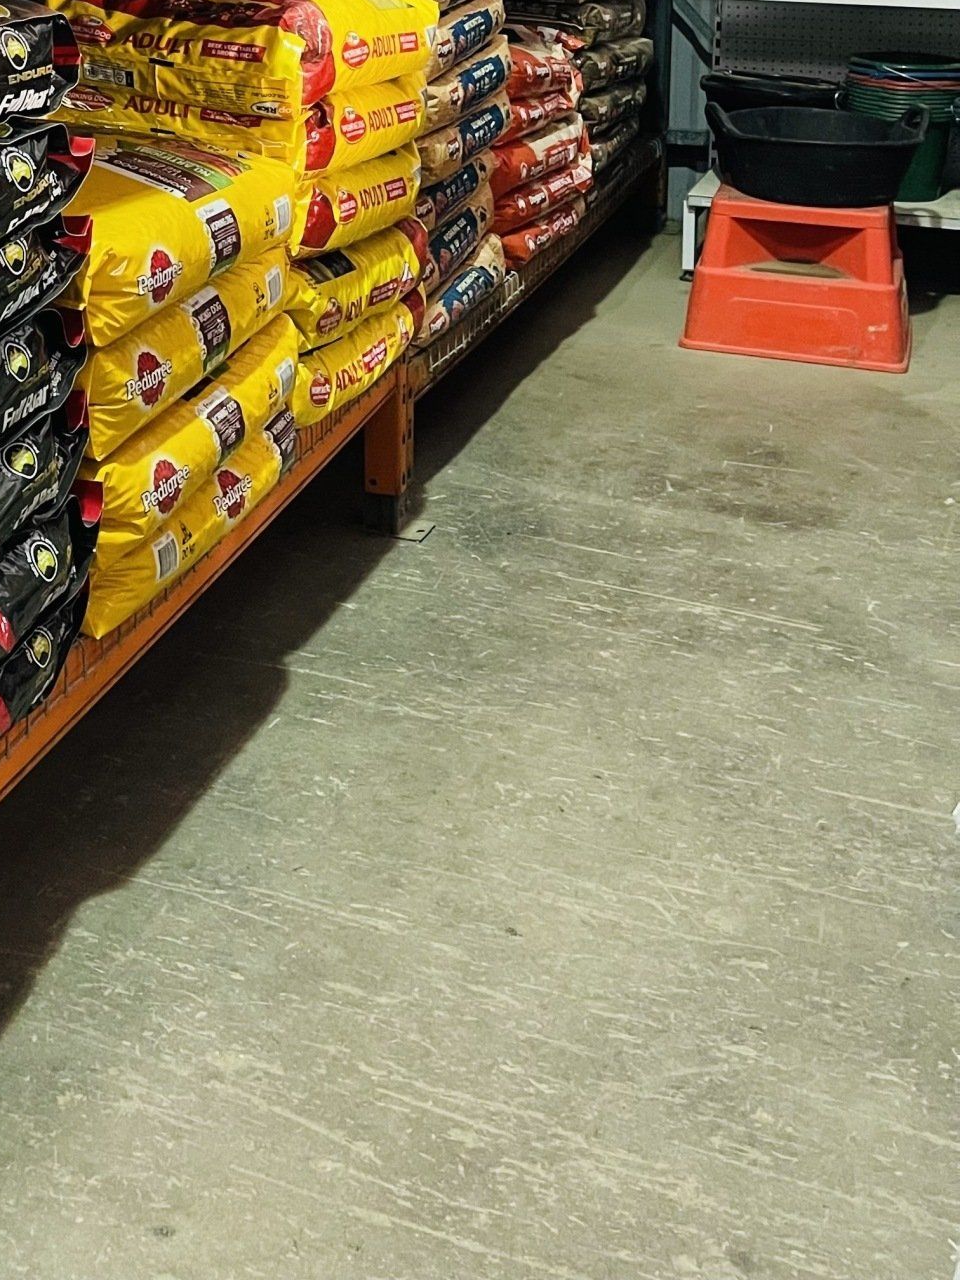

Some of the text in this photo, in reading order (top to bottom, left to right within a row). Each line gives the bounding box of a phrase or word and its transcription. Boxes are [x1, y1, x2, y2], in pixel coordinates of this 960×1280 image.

[122, 31, 198, 57] ADULT
[371, 33, 397, 59] ADULT
[7, 63, 55, 86] ENDURO
[123, 93, 192, 119] ADULT
[367, 105, 395, 133] ADULT
[139, 166, 189, 193] WORKING
[194, 165, 212, 178] NO
[358, 184, 385, 209] ADULT
[137, 261, 183, 296] Pedigree
[126, 358, 174, 401] Pedigree
[140, 464, 190, 514] Pedigree
[212, 473, 253, 517] Pedigree
